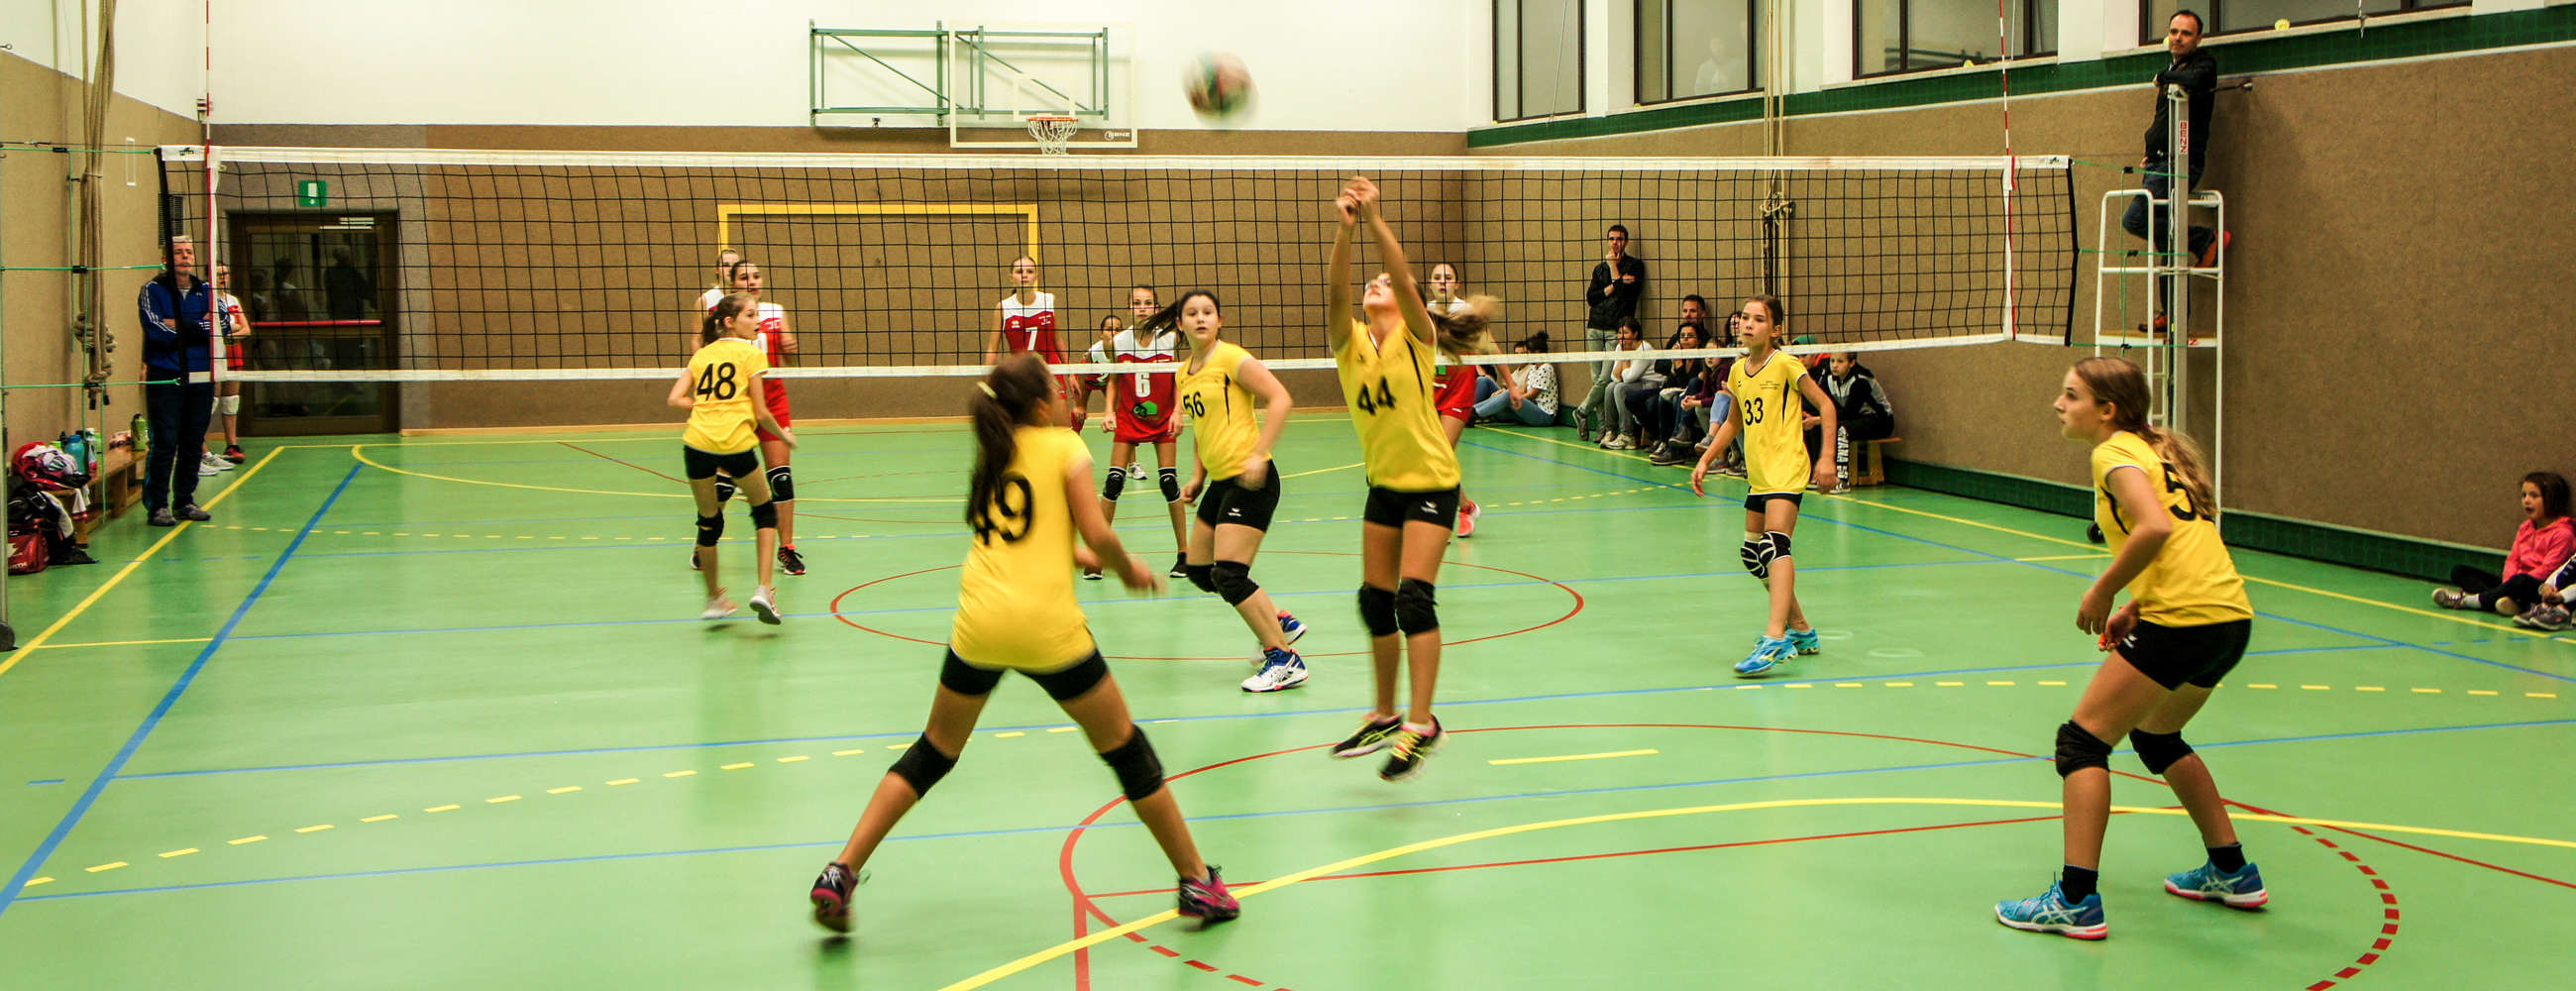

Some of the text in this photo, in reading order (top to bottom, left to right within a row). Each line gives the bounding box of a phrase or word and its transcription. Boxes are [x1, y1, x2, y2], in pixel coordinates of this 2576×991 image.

[1024, 327, 1038, 351] 7
[697, 362, 736, 400] 48
[1134, 373, 1151, 398] 6
[1357, 376, 1397, 415] 44
[1183, 390, 1206, 419] 56
[1745, 397, 1764, 426] 33
[2161, 462, 2213, 522] 5
